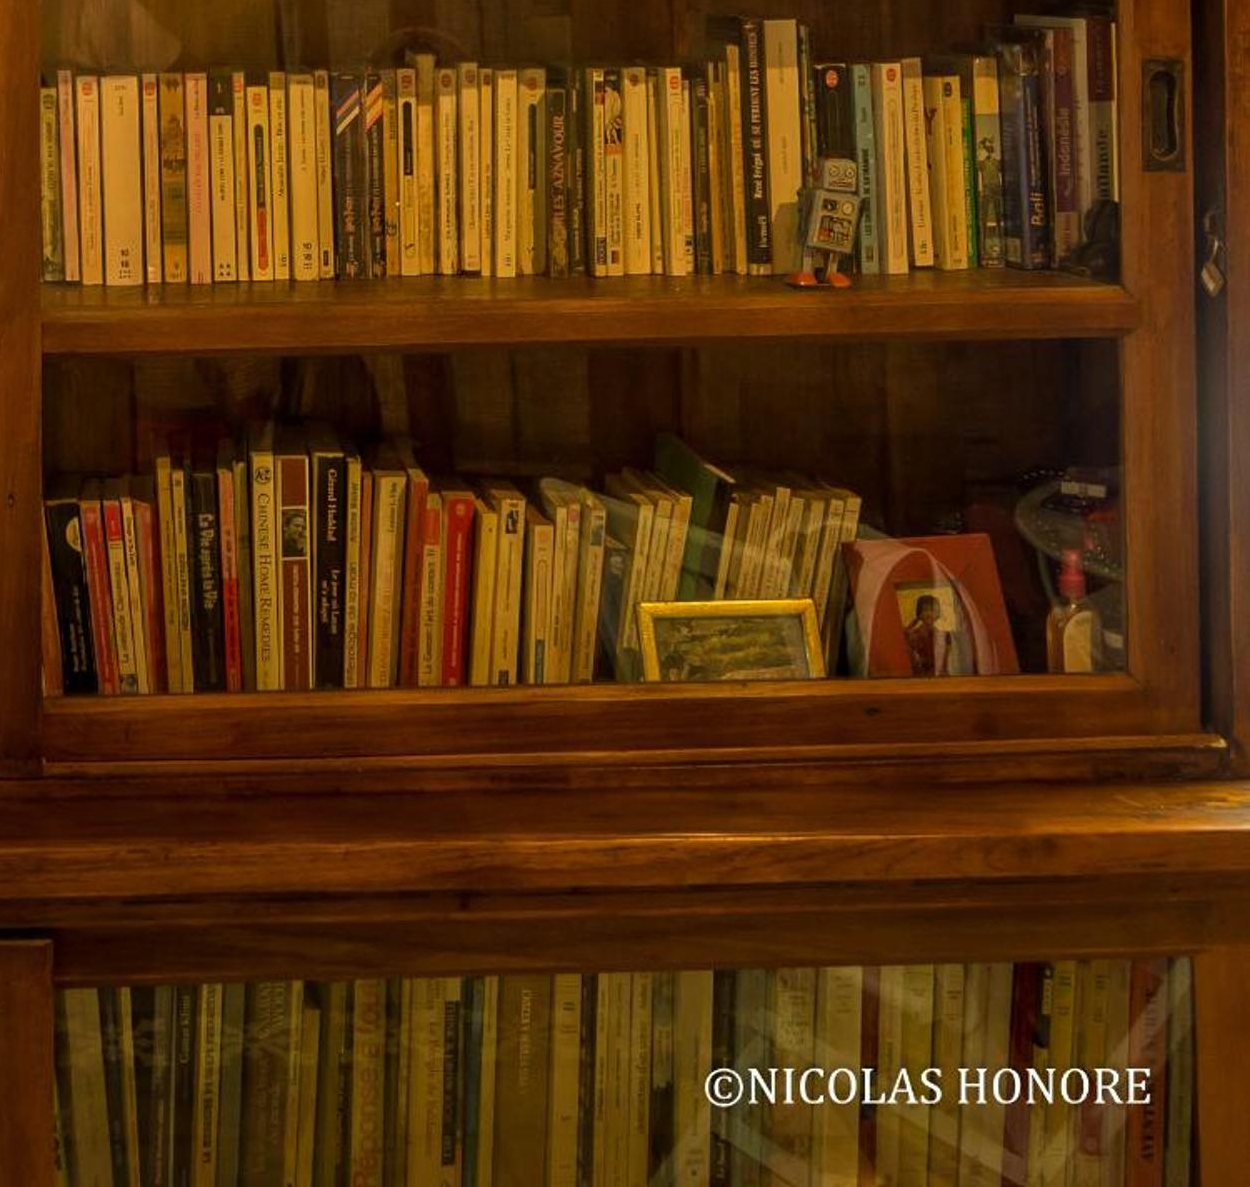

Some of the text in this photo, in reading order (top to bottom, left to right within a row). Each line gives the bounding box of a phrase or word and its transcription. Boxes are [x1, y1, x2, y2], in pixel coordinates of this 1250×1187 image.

[552, 113, 565, 189] AZNAVOUR
[1029, 192, 1044, 227] Bali
[257, 493, 272, 662] CHINESE HOME REMEDIES
